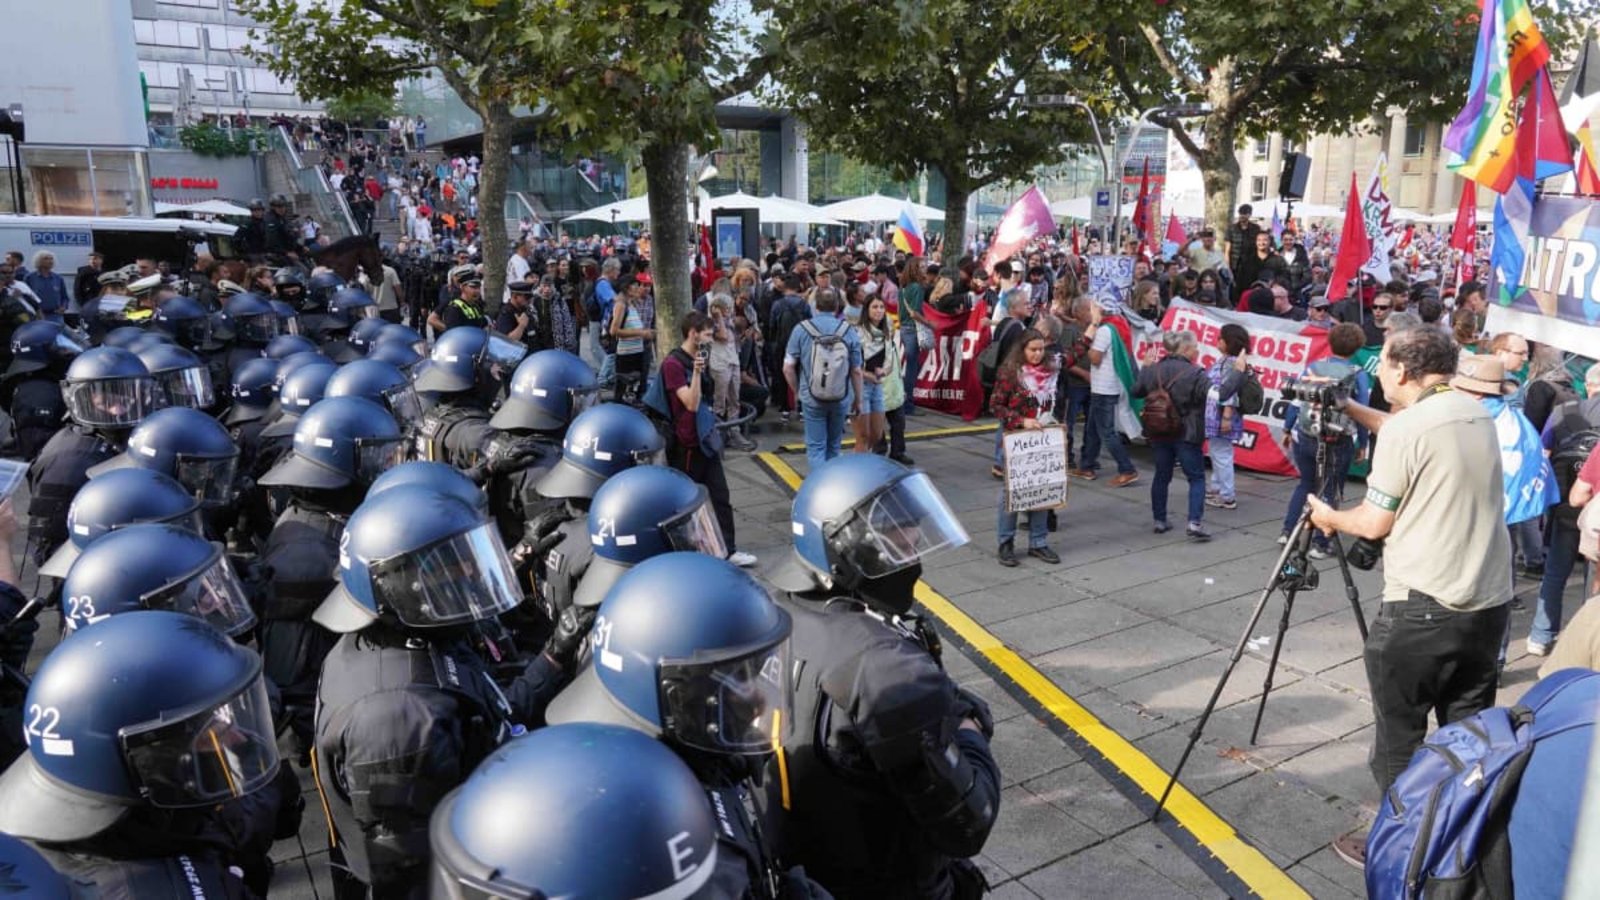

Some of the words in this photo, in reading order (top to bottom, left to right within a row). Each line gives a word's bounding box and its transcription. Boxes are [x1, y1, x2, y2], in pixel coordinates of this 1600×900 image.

[31, 232, 90, 244] POLIZEI
[1012, 434, 1050, 452] Metall
[598, 518, 615, 538] 21
[68, 595, 95, 619] 23
[594, 615, 613, 651] 31
[29, 703, 60, 739] 22
[667, 831, 698, 880] E
